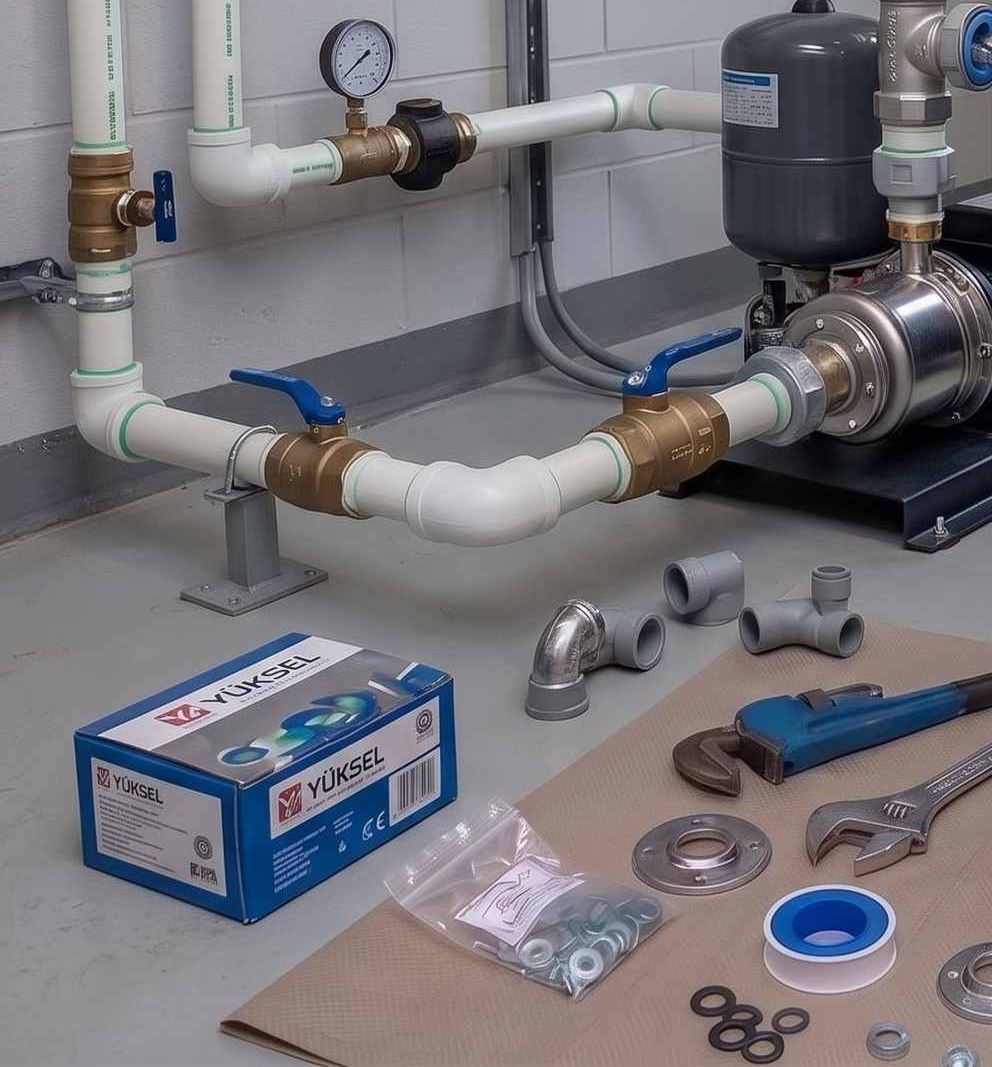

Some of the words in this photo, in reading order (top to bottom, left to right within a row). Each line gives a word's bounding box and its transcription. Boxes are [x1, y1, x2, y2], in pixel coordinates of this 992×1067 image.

[200, 654, 322, 705] YÜKSEL
[112, 774, 164, 805] YÜKSEL
[307, 746, 385, 800] YÜKSEL
